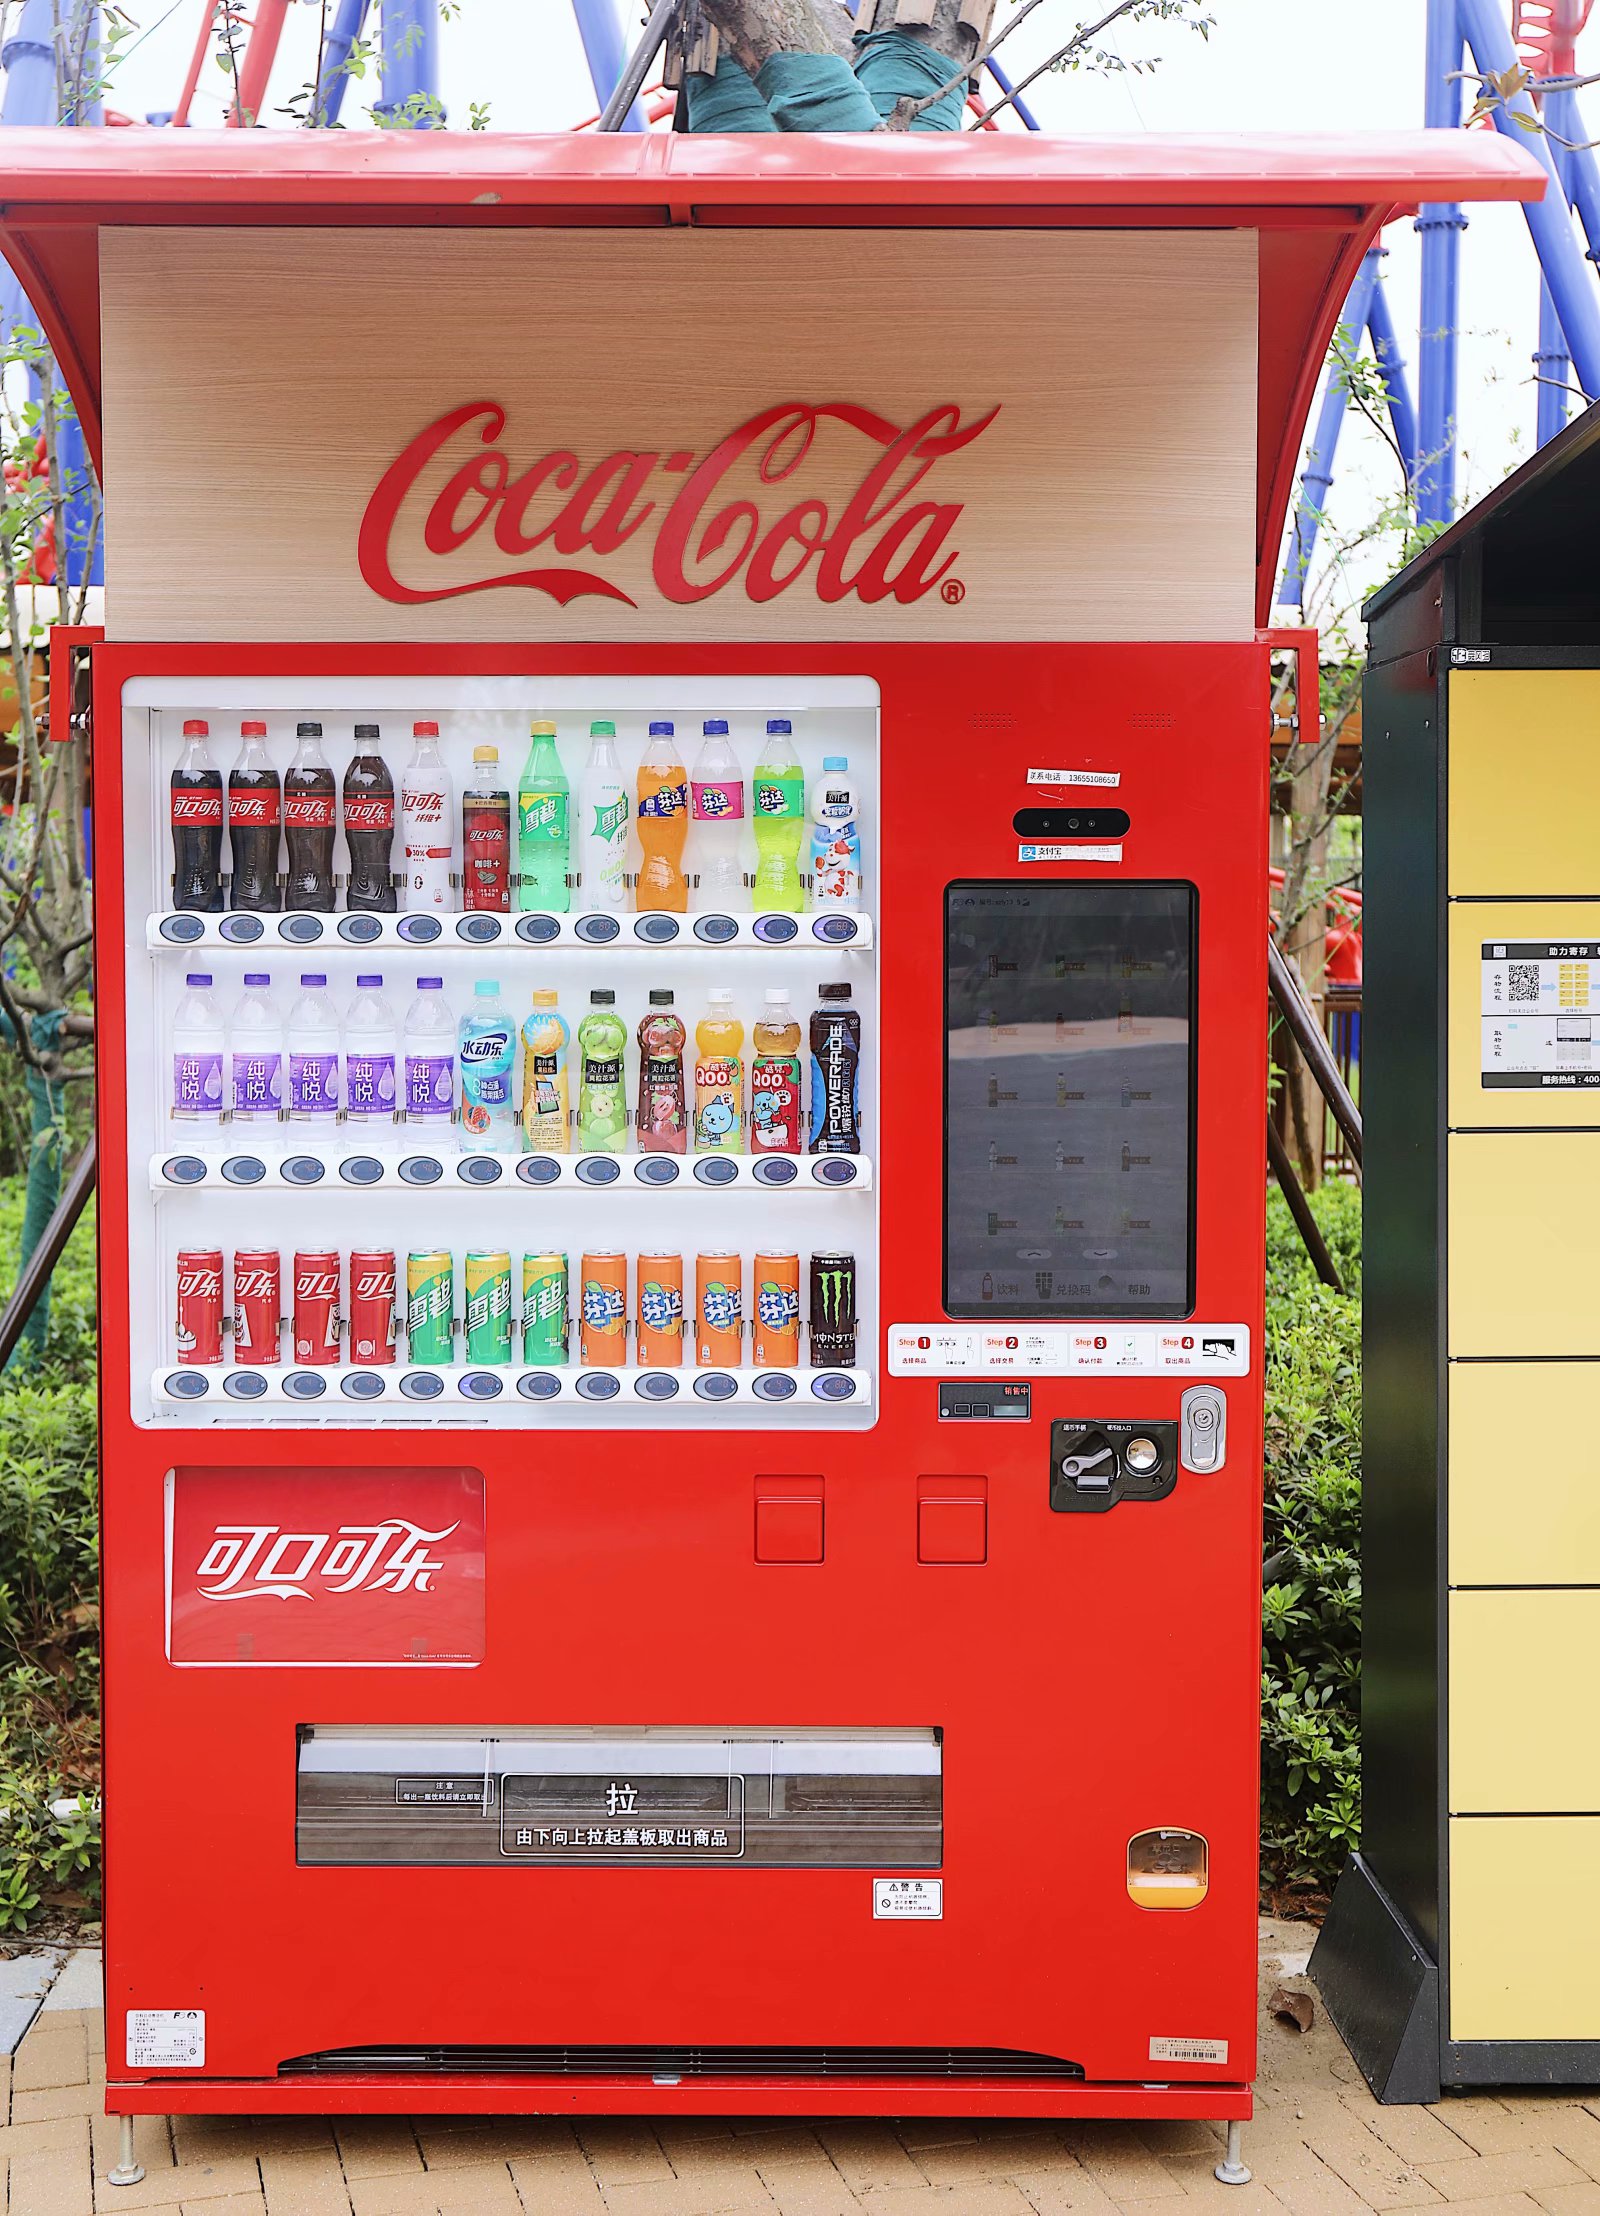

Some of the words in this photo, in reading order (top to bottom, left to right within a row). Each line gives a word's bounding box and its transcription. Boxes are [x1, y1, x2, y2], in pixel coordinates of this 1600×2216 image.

[358, 402, 1001, 608] Coca-Cola
[229, 798, 270, 817] 口可乐
[658, 789, 684, 811] 芬达
[702, 793, 729, 812] 芬达
[759, 790, 784, 808] 芬达
[525, 799, 558, 834] 雪碧
[600, 798, 627, 834] 雪碧
[1038, 847, 1062, 855] 支付宝
[1549, 946, 1588, 956] 助力寄存
[462, 1040, 504, 1056] 水动乐
[182, 1060, 200, 1100] 纯悦
[246, 1060, 265, 1100] 纯悦
[302, 1061, 320, 1102] 纯悦
[355, 1062, 373, 1102] 纯悦
[589, 1064, 616, 1074] 美汁源
[652, 1064, 676, 1074] 美汁源
[829, 1024, 843, 1134] POWERADE
[1542, 1076, 1600, 1084] 服务热线：400
[412, 1063, 430, 1104] 纯悦
[178, 1269, 222, 1297] 可乐
[235, 1268, 279, 1298] 可乐
[296, 1272, 340, 1300] 可口
[1056, 1284, 1092, 1296] 兑换码
[1128, 1284, 1150, 1296] 帮助
[409, 1278, 454, 1332] 雪碧
[468, 1278, 512, 1333] 雪碧
[523, 1280, 566, 1330] 雪碧
[584, 1290, 625, 1320] 芬达
[642, 1290, 682, 1320] 芬达
[760, 1290, 798, 1320] 芬达
[899, 1338, 916, 1346] Step
[987, 1338, 1004, 1346] Step
[1076, 1338, 1092, 1346] Step
[1162, 1338, 1179, 1346] Step
[1004, 1386, 1028, 1395] 销售中
[196, 1518, 461, 1601] 可口可乐
[605, 1782, 640, 1817] 拉
[516, 1828, 728, 1848] 由下向上拉起盖板取出商品
